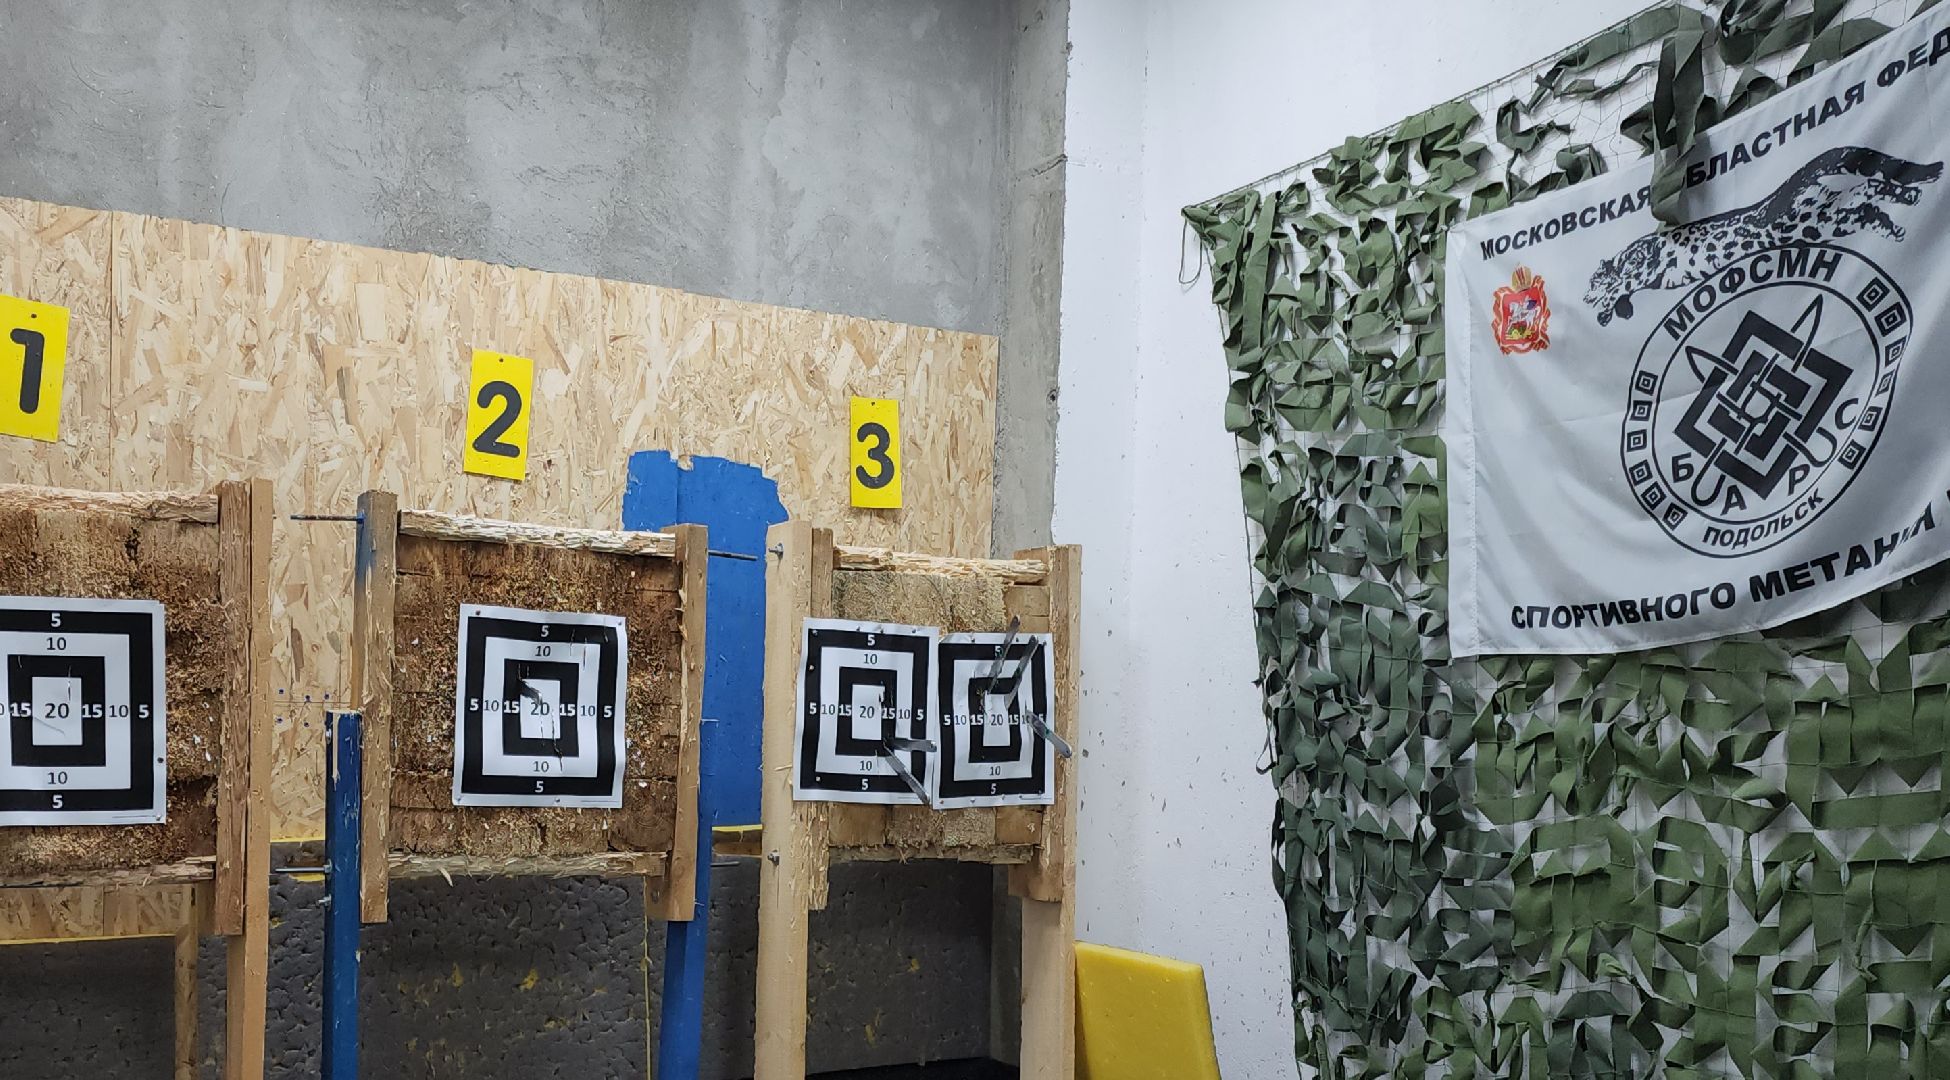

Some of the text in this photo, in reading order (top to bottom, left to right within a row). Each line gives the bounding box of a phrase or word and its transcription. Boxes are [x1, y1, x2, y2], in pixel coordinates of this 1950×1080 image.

[1480, 185, 1651, 261] МОСКОВСКАЯ
[1681, 80, 1866, 189] БЛАСТНАЯ
[1663, 249, 1843, 341] МОФСМН
[10, 328, 45, 414] 1
[472, 381, 522, 459] 2
[855, 422, 895, 490] 3
[1702, 488, 1825, 550] ПОДОЛЬСК
[1511, 582, 1736, 630] СПОРТИВНОГО
[51, 612, 61, 627] 5
[541, 625, 549, 638] 5
[46, 637, 67, 651] 10
[868, 634, 876, 646] 5
[535, 645, 551, 657] 10
[864, 653, 877, 665] 10
[10, 702, 31, 717] 15
[45, 703, 69, 719] 20
[82, 704, 102, 718] 15
[109, 704, 129, 718] 10
[139, 704, 149, 718] 5
[469, 698, 613, 717] 5 10 15 20 15 10 5
[809, 702, 924, 720] 5 10 15 20 15 10 5
[943, 714, 950, 726] 5
[955, 715, 966, 726] 10
[970, 714, 983, 726] 15
[991, 714, 1003, 726] 20
[1008, 714, 1019, 726] 15
[534, 760, 549, 772] 10
[859, 760, 872, 771] 10
[990, 766, 1000, 776] 10
[48, 771, 68, 785] 10
[861, 778, 869, 790] 5
[535, 781, 544, 793] 5
[990, 783, 997, 794] 5
[52, 795, 63, 809] 5
